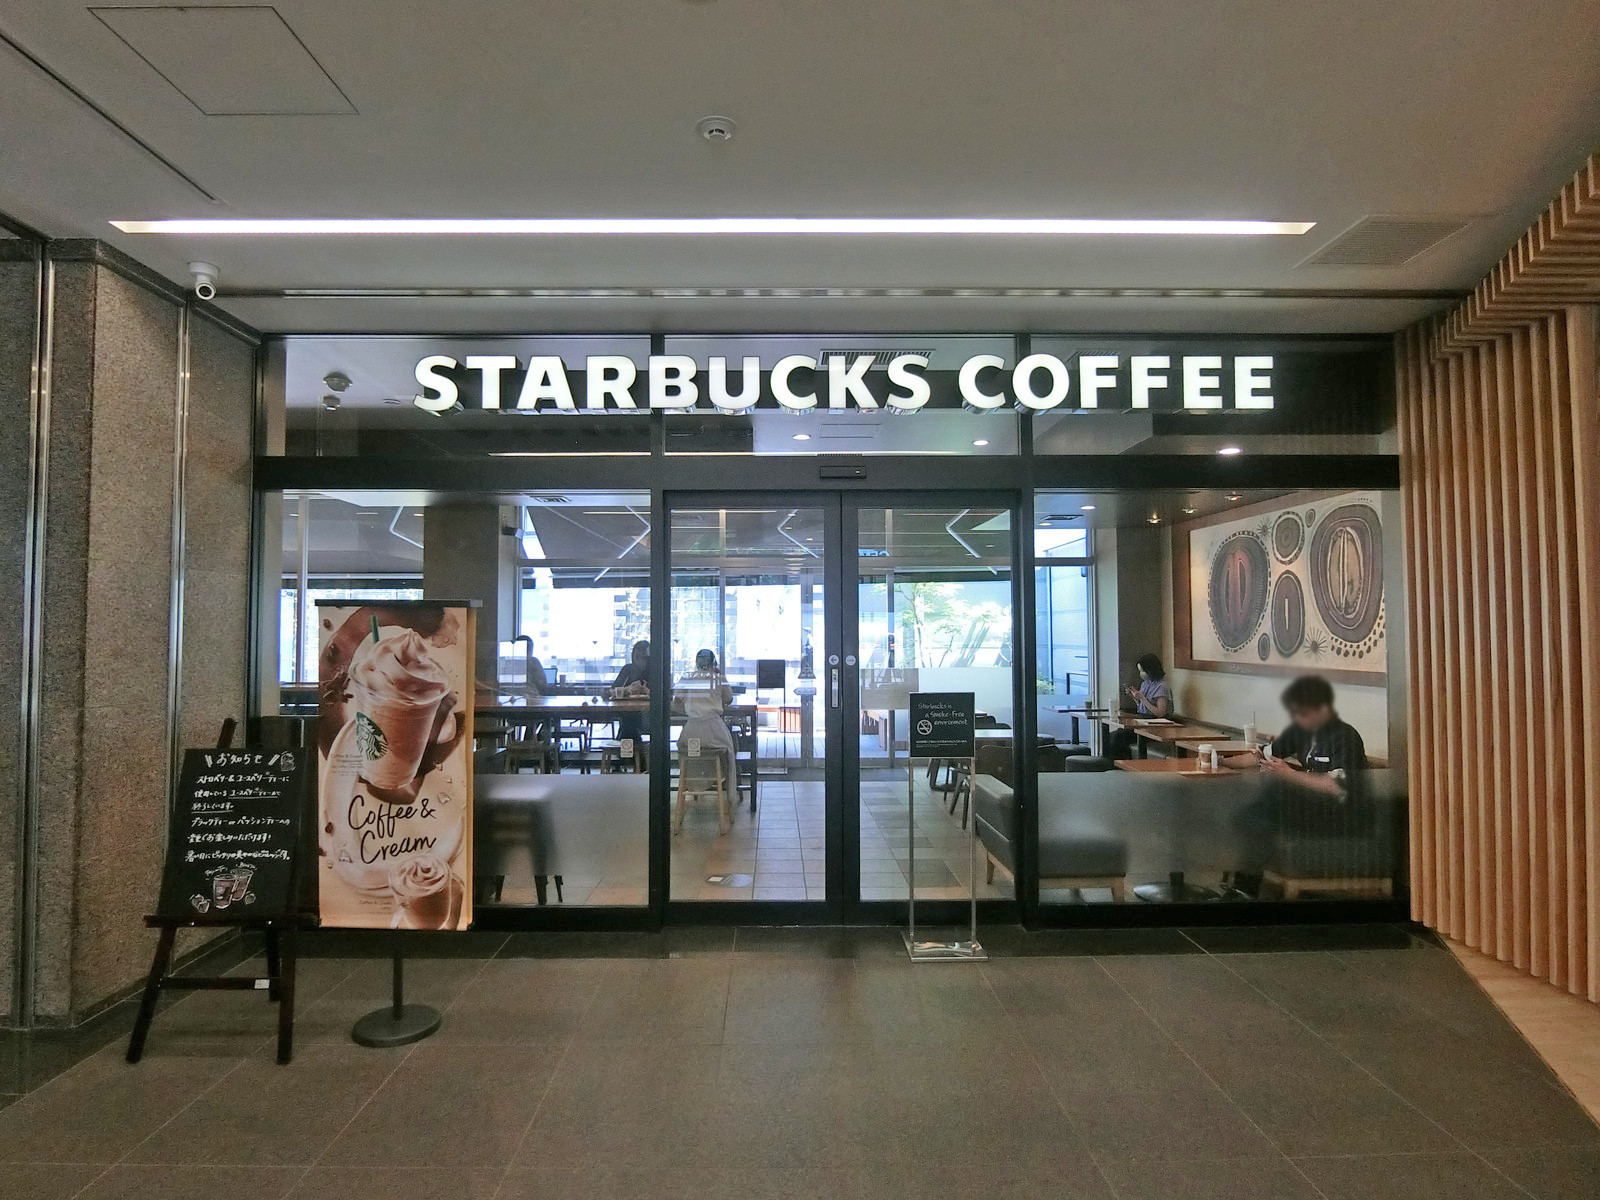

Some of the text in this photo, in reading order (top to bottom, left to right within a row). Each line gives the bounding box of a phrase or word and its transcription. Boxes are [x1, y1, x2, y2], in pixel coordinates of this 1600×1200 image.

[413, 353, 1275, 411] STARBUCKS COFFEE
[216, 752, 263, 767] お知らせ
[348, 795, 437, 838] Coffee &
[360, 830, 437, 864] Cream
